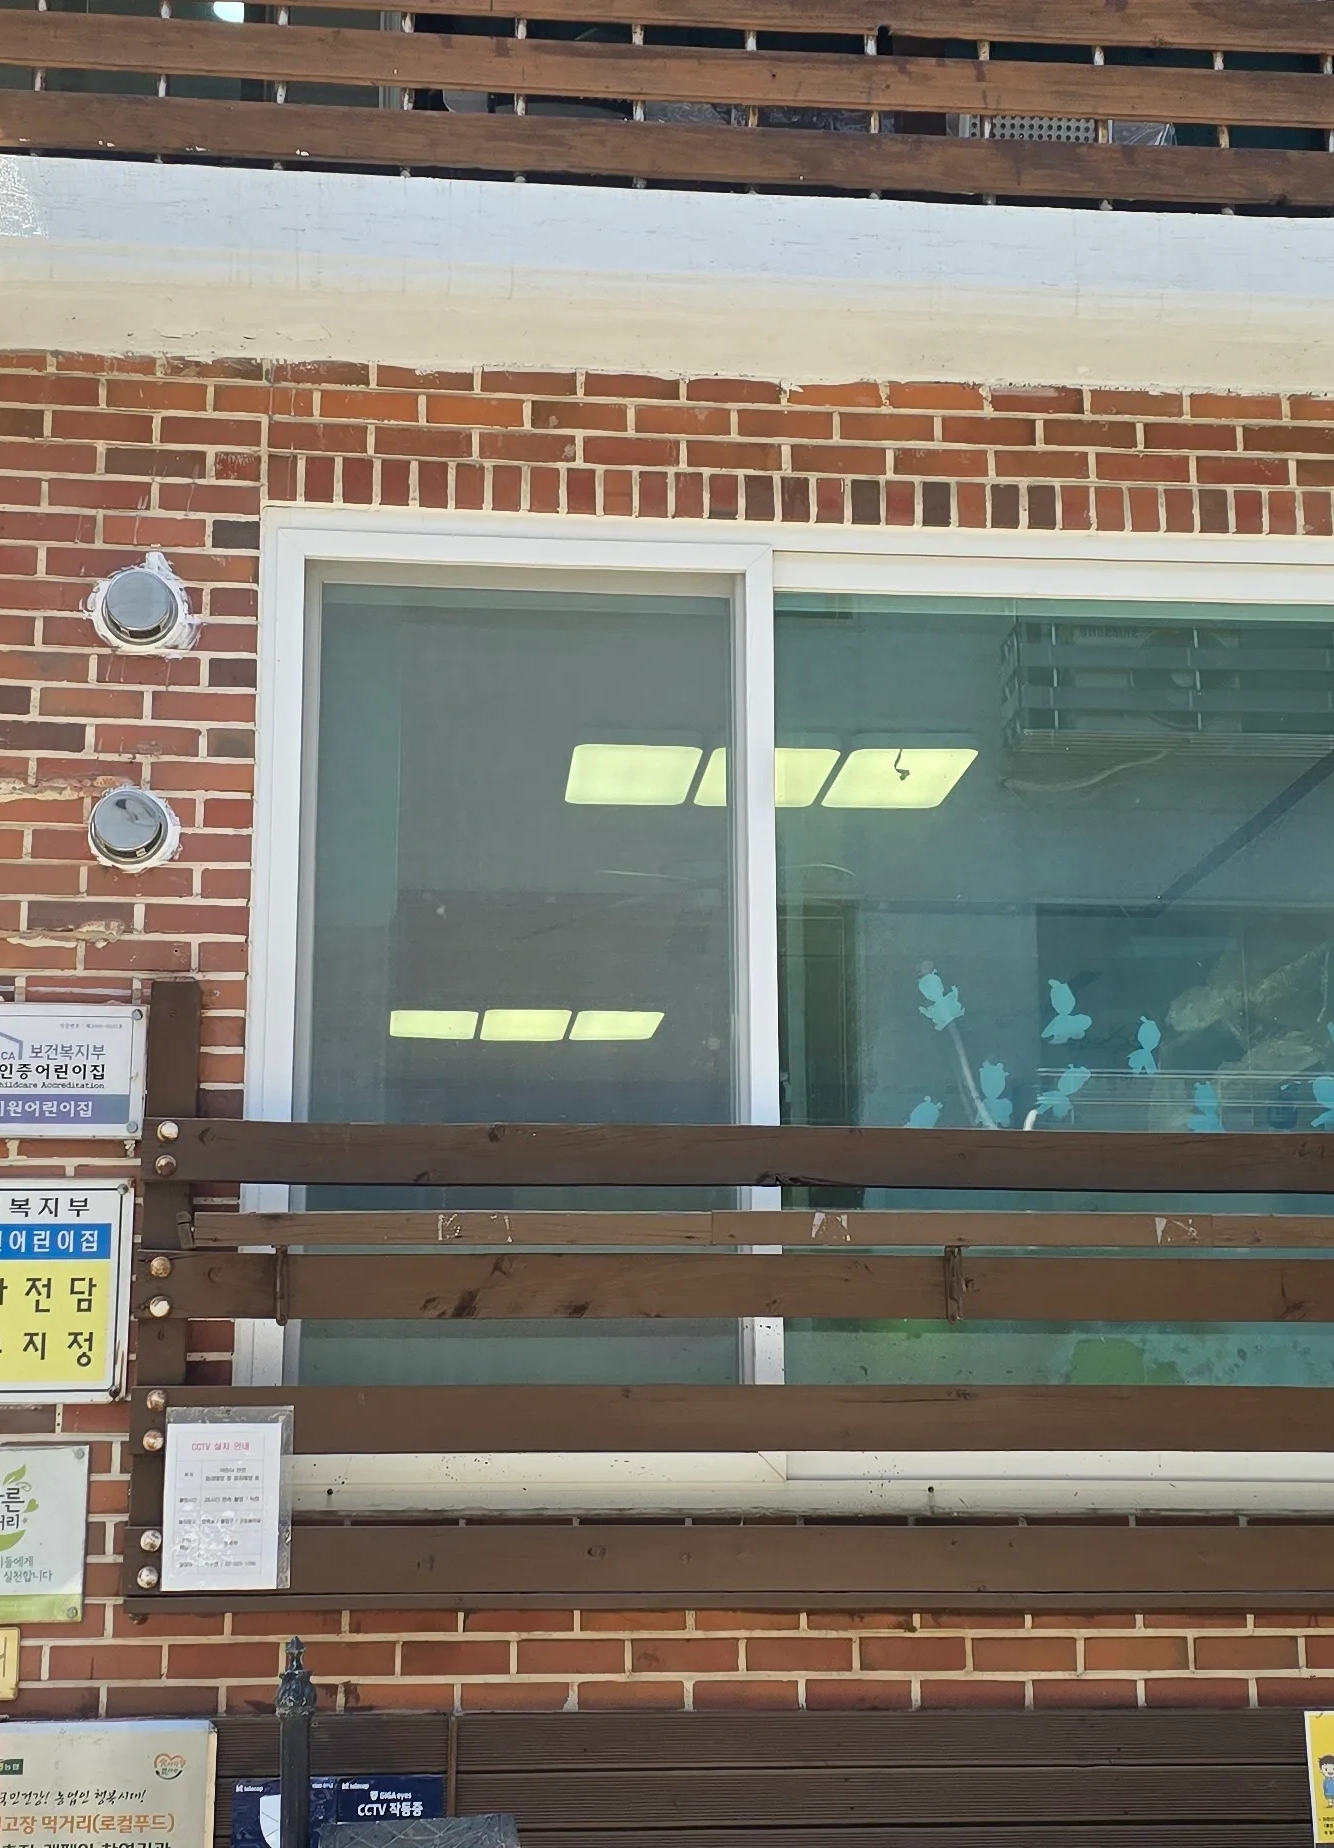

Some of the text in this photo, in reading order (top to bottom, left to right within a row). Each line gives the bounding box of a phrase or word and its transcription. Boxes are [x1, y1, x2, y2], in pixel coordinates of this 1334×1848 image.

[28, 1044, 106, 1060] 보건복지부
[41, 1081, 105, 1089] Accreditation
[191, 1442, 211, 1451] CCTV
[214, 1442, 230, 1451] 설치
[3, 1569, 53, 1584] 실천합니다
[55, 1789, 90, 1806] 농업인
[357, 1801, 423, 1817] CCTV 작동중
[41, 1813, 175, 1834] 먹거리(로컬푸드)
